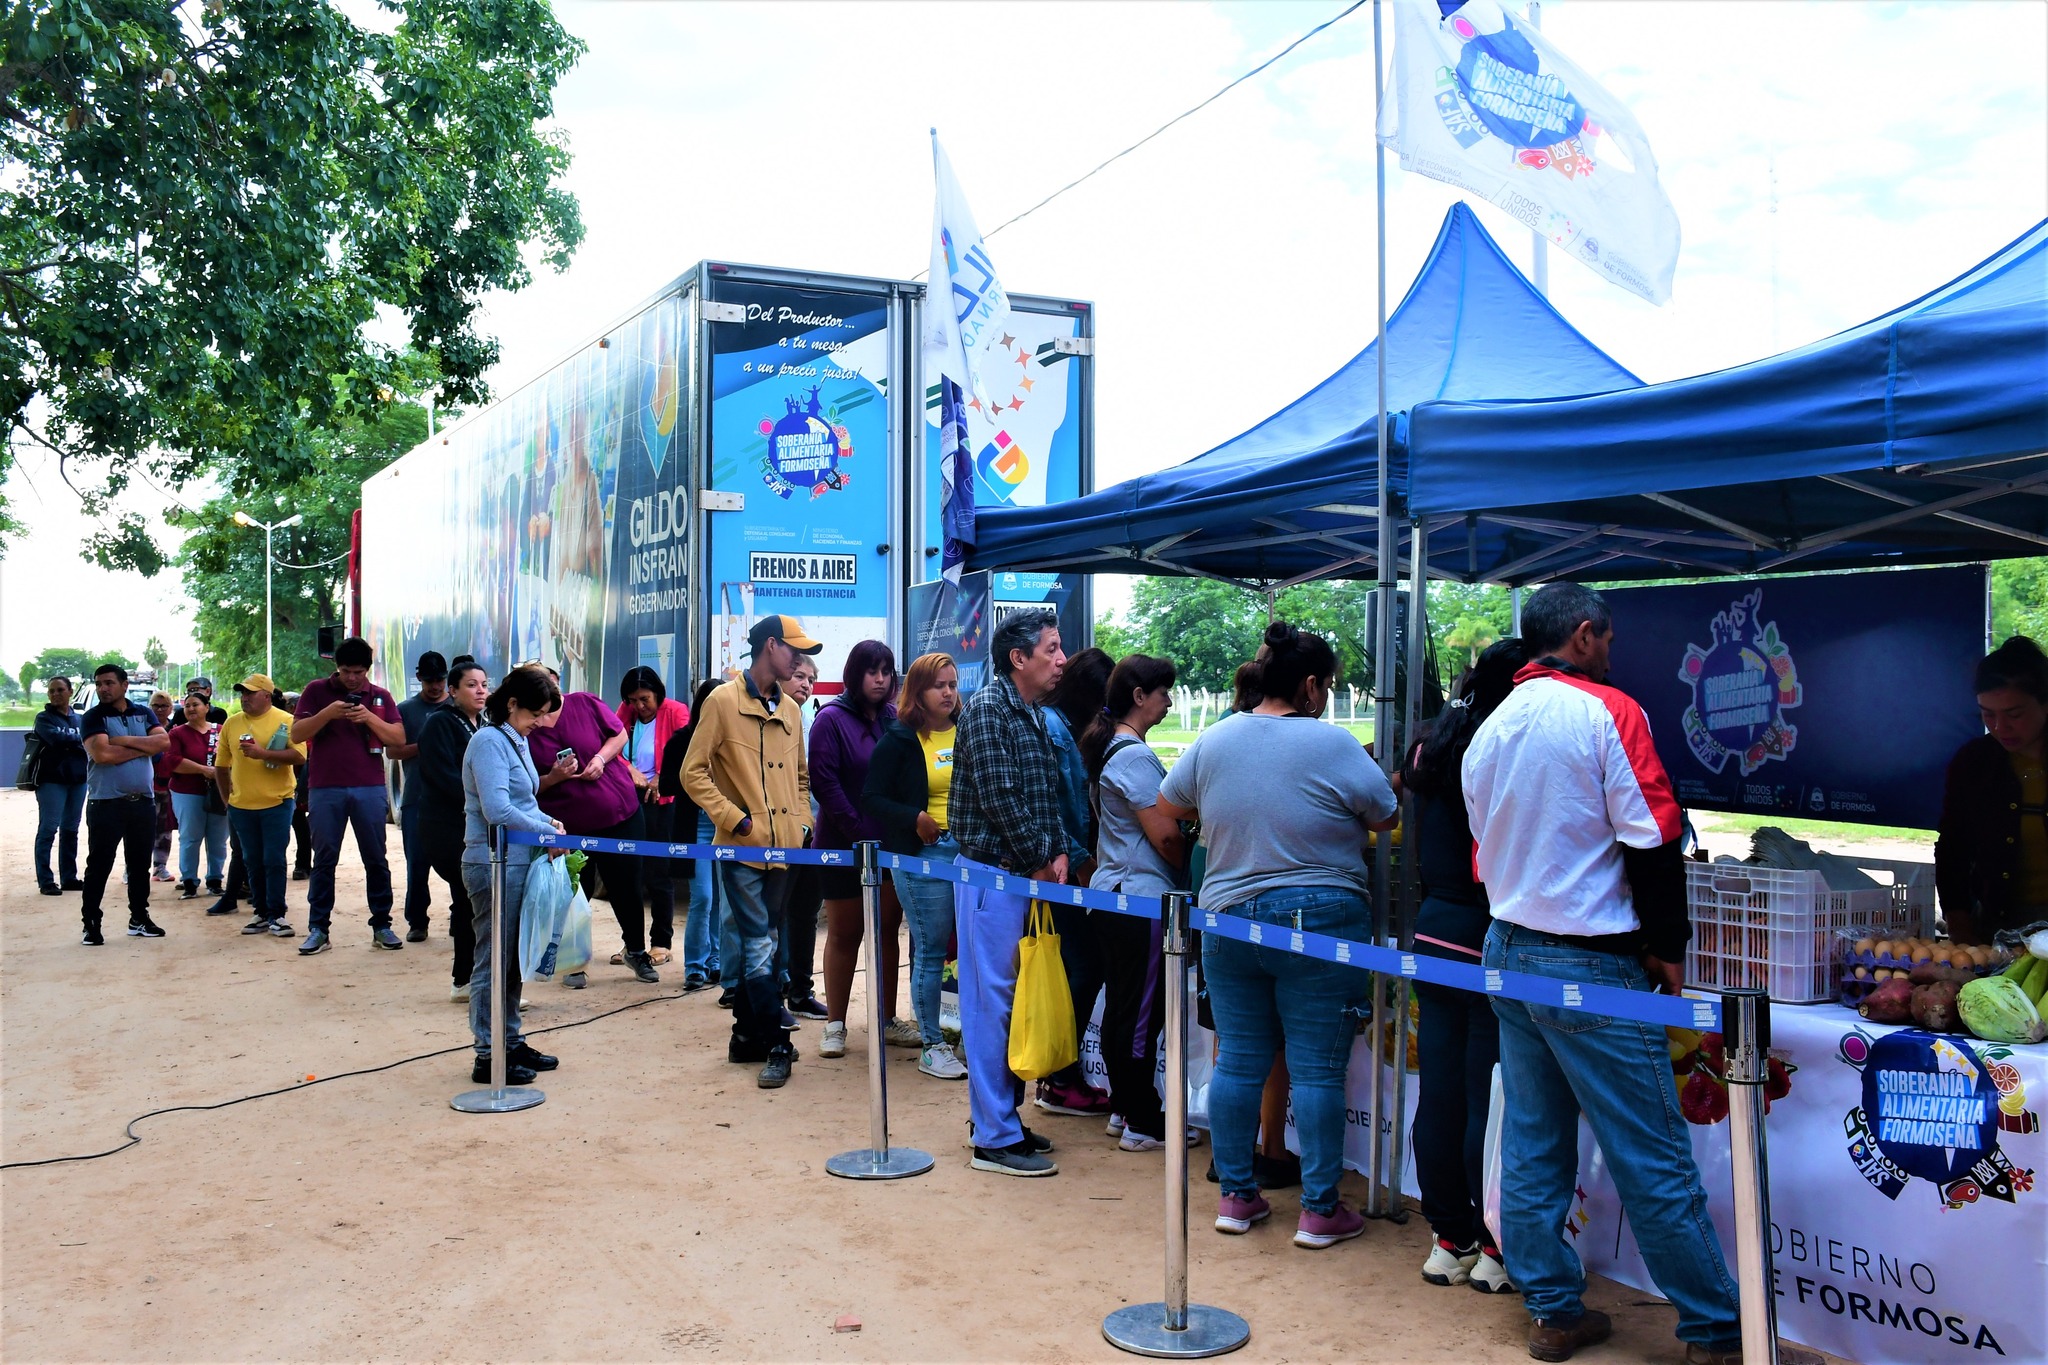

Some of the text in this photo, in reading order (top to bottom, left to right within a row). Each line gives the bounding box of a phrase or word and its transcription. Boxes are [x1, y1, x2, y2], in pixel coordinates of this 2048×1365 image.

[1501, 199, 1539, 227] UNIDOS
[1510, 190, 1543, 215] TODOS
[747, 304, 774, 321] Del
[778, 337, 787, 347] a
[793, 336, 807, 349] tu
[743, 362, 863, 383] a un precio justo!
[777, 431, 823, 448] SOBERANÍA
[778, 443, 834, 460] ALIMENTARIA
[780, 456, 830, 473] FORMOSEÑA
[629, 484, 688, 548] GILDO
[629, 542, 688, 586] INSFRAN
[753, 556, 854, 580] FRENOS A AIRE
[805, 588, 856, 599] DISTANCIA
[1022, 581, 1063, 590] DE FORMOSA
[629, 587, 688, 616] GOBERNADOR
[1744, 795, 1773, 805] UNIDOS
[1746, 784, 1771, 795] TODOS
[1831, 801, 1876, 812] DE FORMOSA
[1879, 1069, 1965, 1098] SOBERANÍA
[1882, 1094, 1984, 1125] ALIMENTARIA
[1881, 1118, 1978, 1150] FORMOSEÑA
[1855, 1157, 1890, 1188] SAF
[1771, 1222, 1936, 1295] OBIERNO
[1795, 1275, 2007, 1357] FORMOSA
